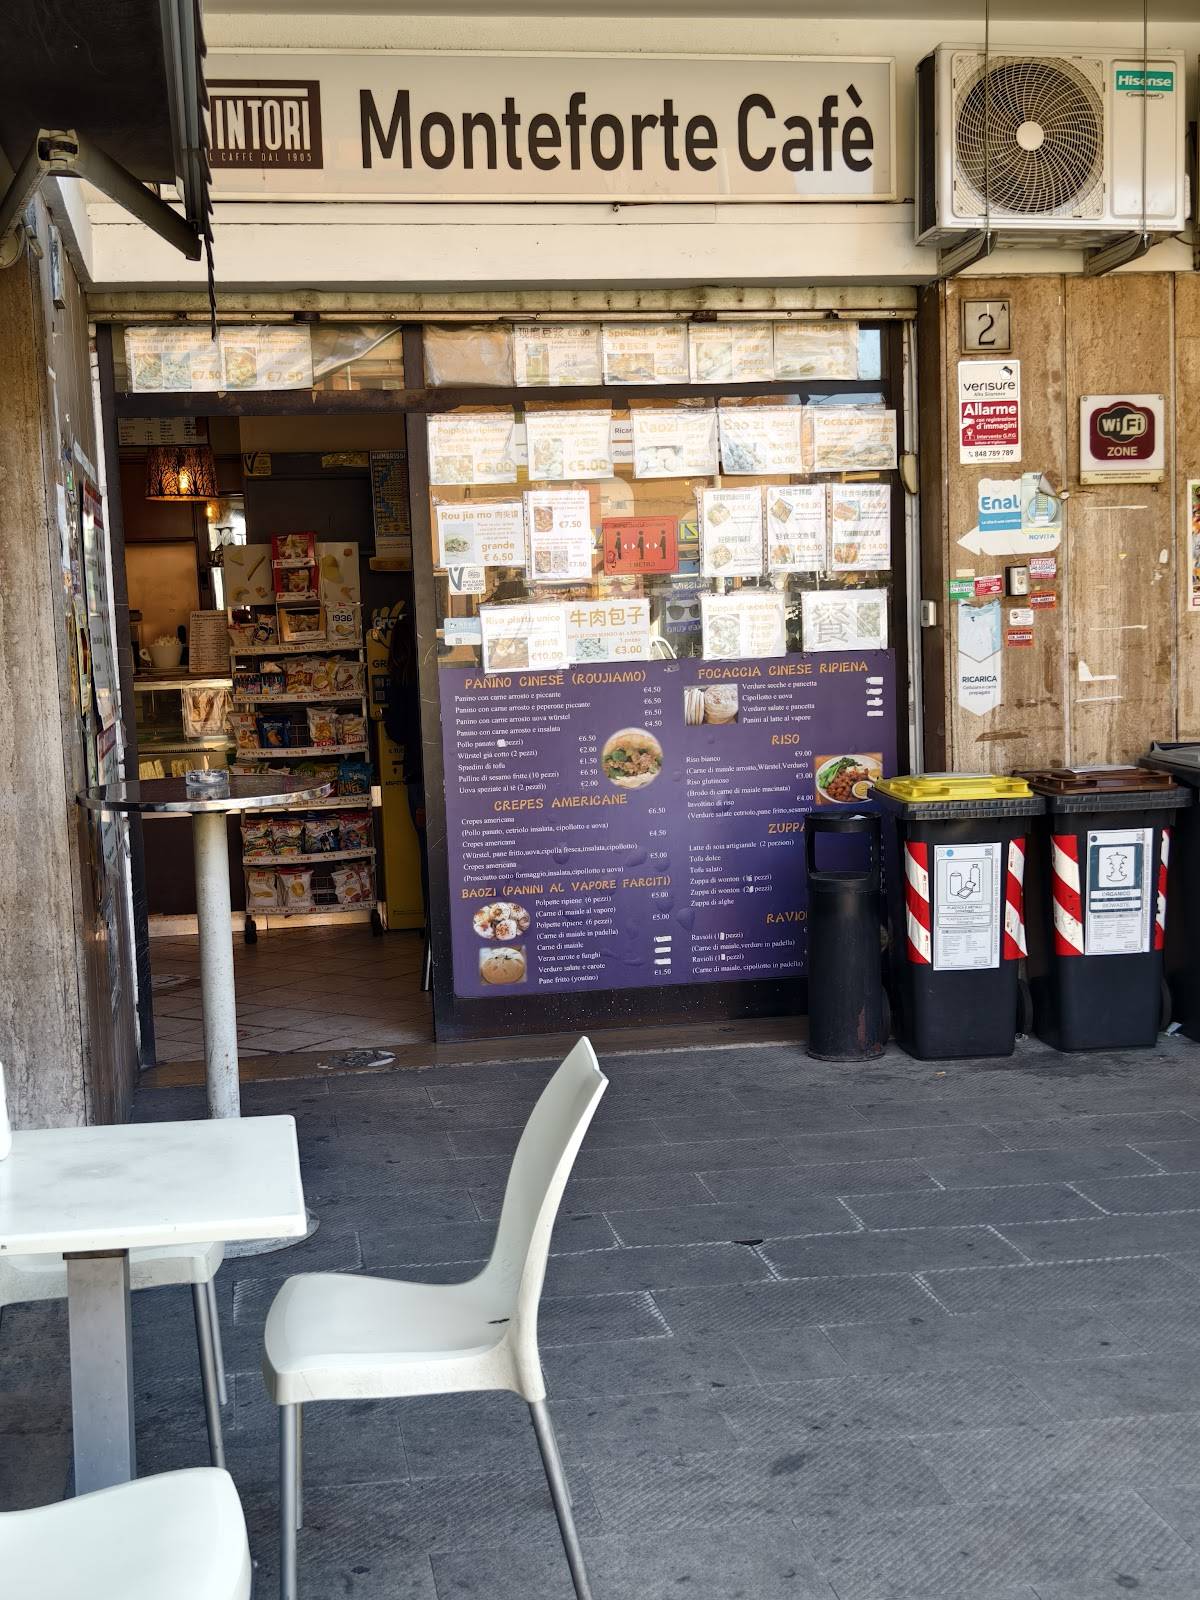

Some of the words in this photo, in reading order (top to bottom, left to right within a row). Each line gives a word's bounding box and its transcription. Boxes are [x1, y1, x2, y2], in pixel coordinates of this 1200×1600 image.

[207, 99, 311, 152] INTORI
[359, 89, 718, 172] Monteforte
[738, 84, 875, 173] Cafè
[978, 313, 996, 345] 2
[963, 381, 1016, 391] verisure
[963, 403, 1017, 416] Allarme
[1107, 446, 1138, 457] ZONE
[981, 494, 1022, 511] Enal
[441, 511, 461, 520] Rou
[332, 614, 353, 622] 1936
[569, 605, 646, 628] 牛肉包子
[698, 667, 761, 679] FOCACCIA
[769, 664, 812, 675] CINESE
[820, 662, 868, 673] RIPIENA
[962, 675, 998, 683] RICARICA
[465, 677, 511, 689] PANINO
[520, 675, 564, 686] CINESE
[572, 671, 646, 684] (ROUJIAMO)
[771, 734, 800, 745] RISO
[494, 799, 544, 811] CREPES
[552, 794, 627, 808] AMERICANE
[462, 888, 496, 898] BAOZI
[503, 886, 543, 896] (PANINI
[550, 883, 564, 892] AL
[572, 881, 616, 891] VAPORE
[623, 877, 671, 887] FARCITI)
[766, 911, 808, 926] RAVIO
